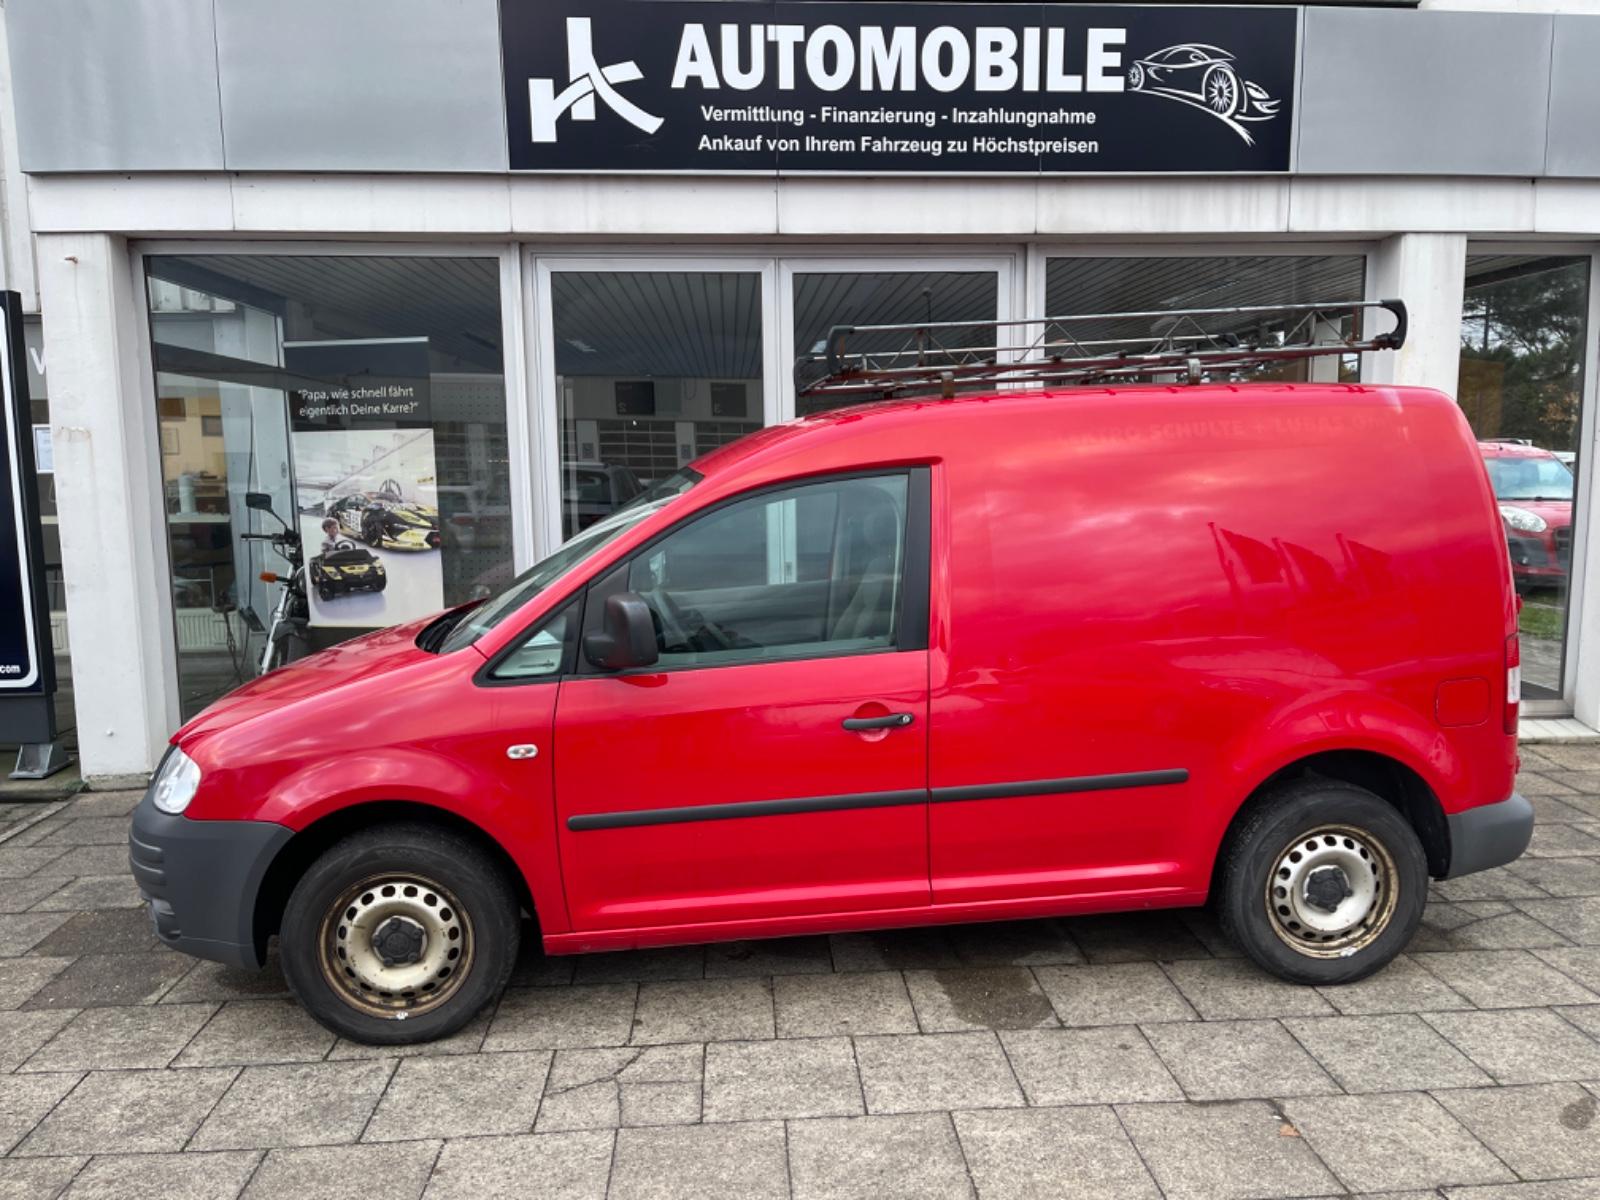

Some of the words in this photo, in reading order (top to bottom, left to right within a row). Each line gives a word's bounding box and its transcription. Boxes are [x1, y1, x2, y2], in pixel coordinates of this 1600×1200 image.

[670, 22, 1127, 93] AUTOMOBILE
[701, 105, 805, 126] Vermittlung
[821, 106, 936, 127] Finanzierung
[952, 107, 1097, 128] Inzahlungnahme
[698, 134, 763, 151] Ankauf
[767, 138, 799, 151] von
[805, 135, 855, 151] Ihrem
[861, 136, 942, 156] Fahrzeug
[947, 140, 967, 152] zu
[973, 136, 1099, 156] Höchstpreisen
[331, 388, 349, 399] wie
[351, 386, 387, 399] schnell
[388, 385, 414, 398] fährt
[299, 404, 349, 418] eigentlich
[350, 403, 380, 415] Deine
